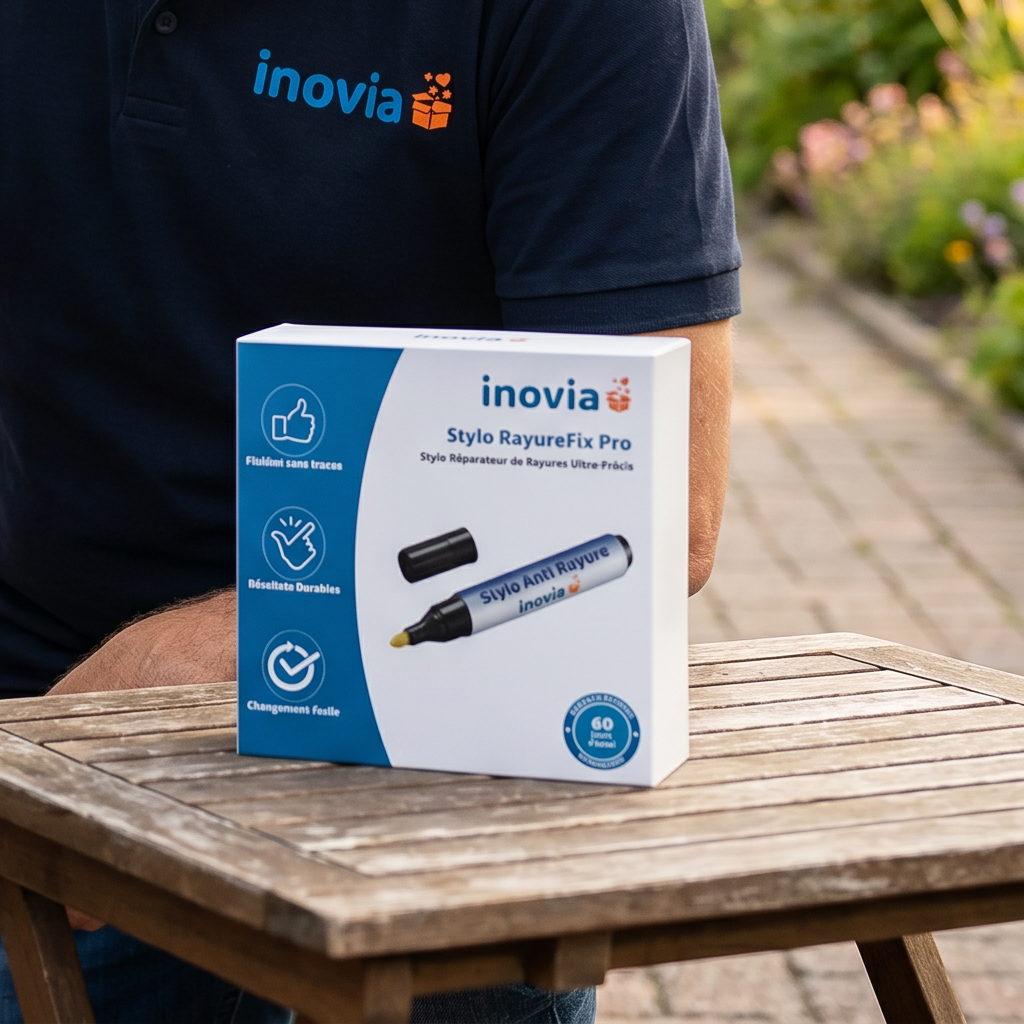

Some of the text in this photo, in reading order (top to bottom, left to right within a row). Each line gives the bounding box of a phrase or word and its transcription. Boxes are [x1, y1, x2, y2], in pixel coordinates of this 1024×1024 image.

[253, 48, 403, 124] inovia
[482, 374, 600, 411] inovia
[446, 427, 632, 451] Stylo RayureFix Pro
[285, 459, 309, 469] sans
[420, 451, 447, 464] Stylo
[510, 456, 524, 466] de
[526, 457, 568, 469] Rayures
[295, 581, 341, 595] Durables
[519, 586, 566, 613] inovia
[590, 716, 614, 732] 60
